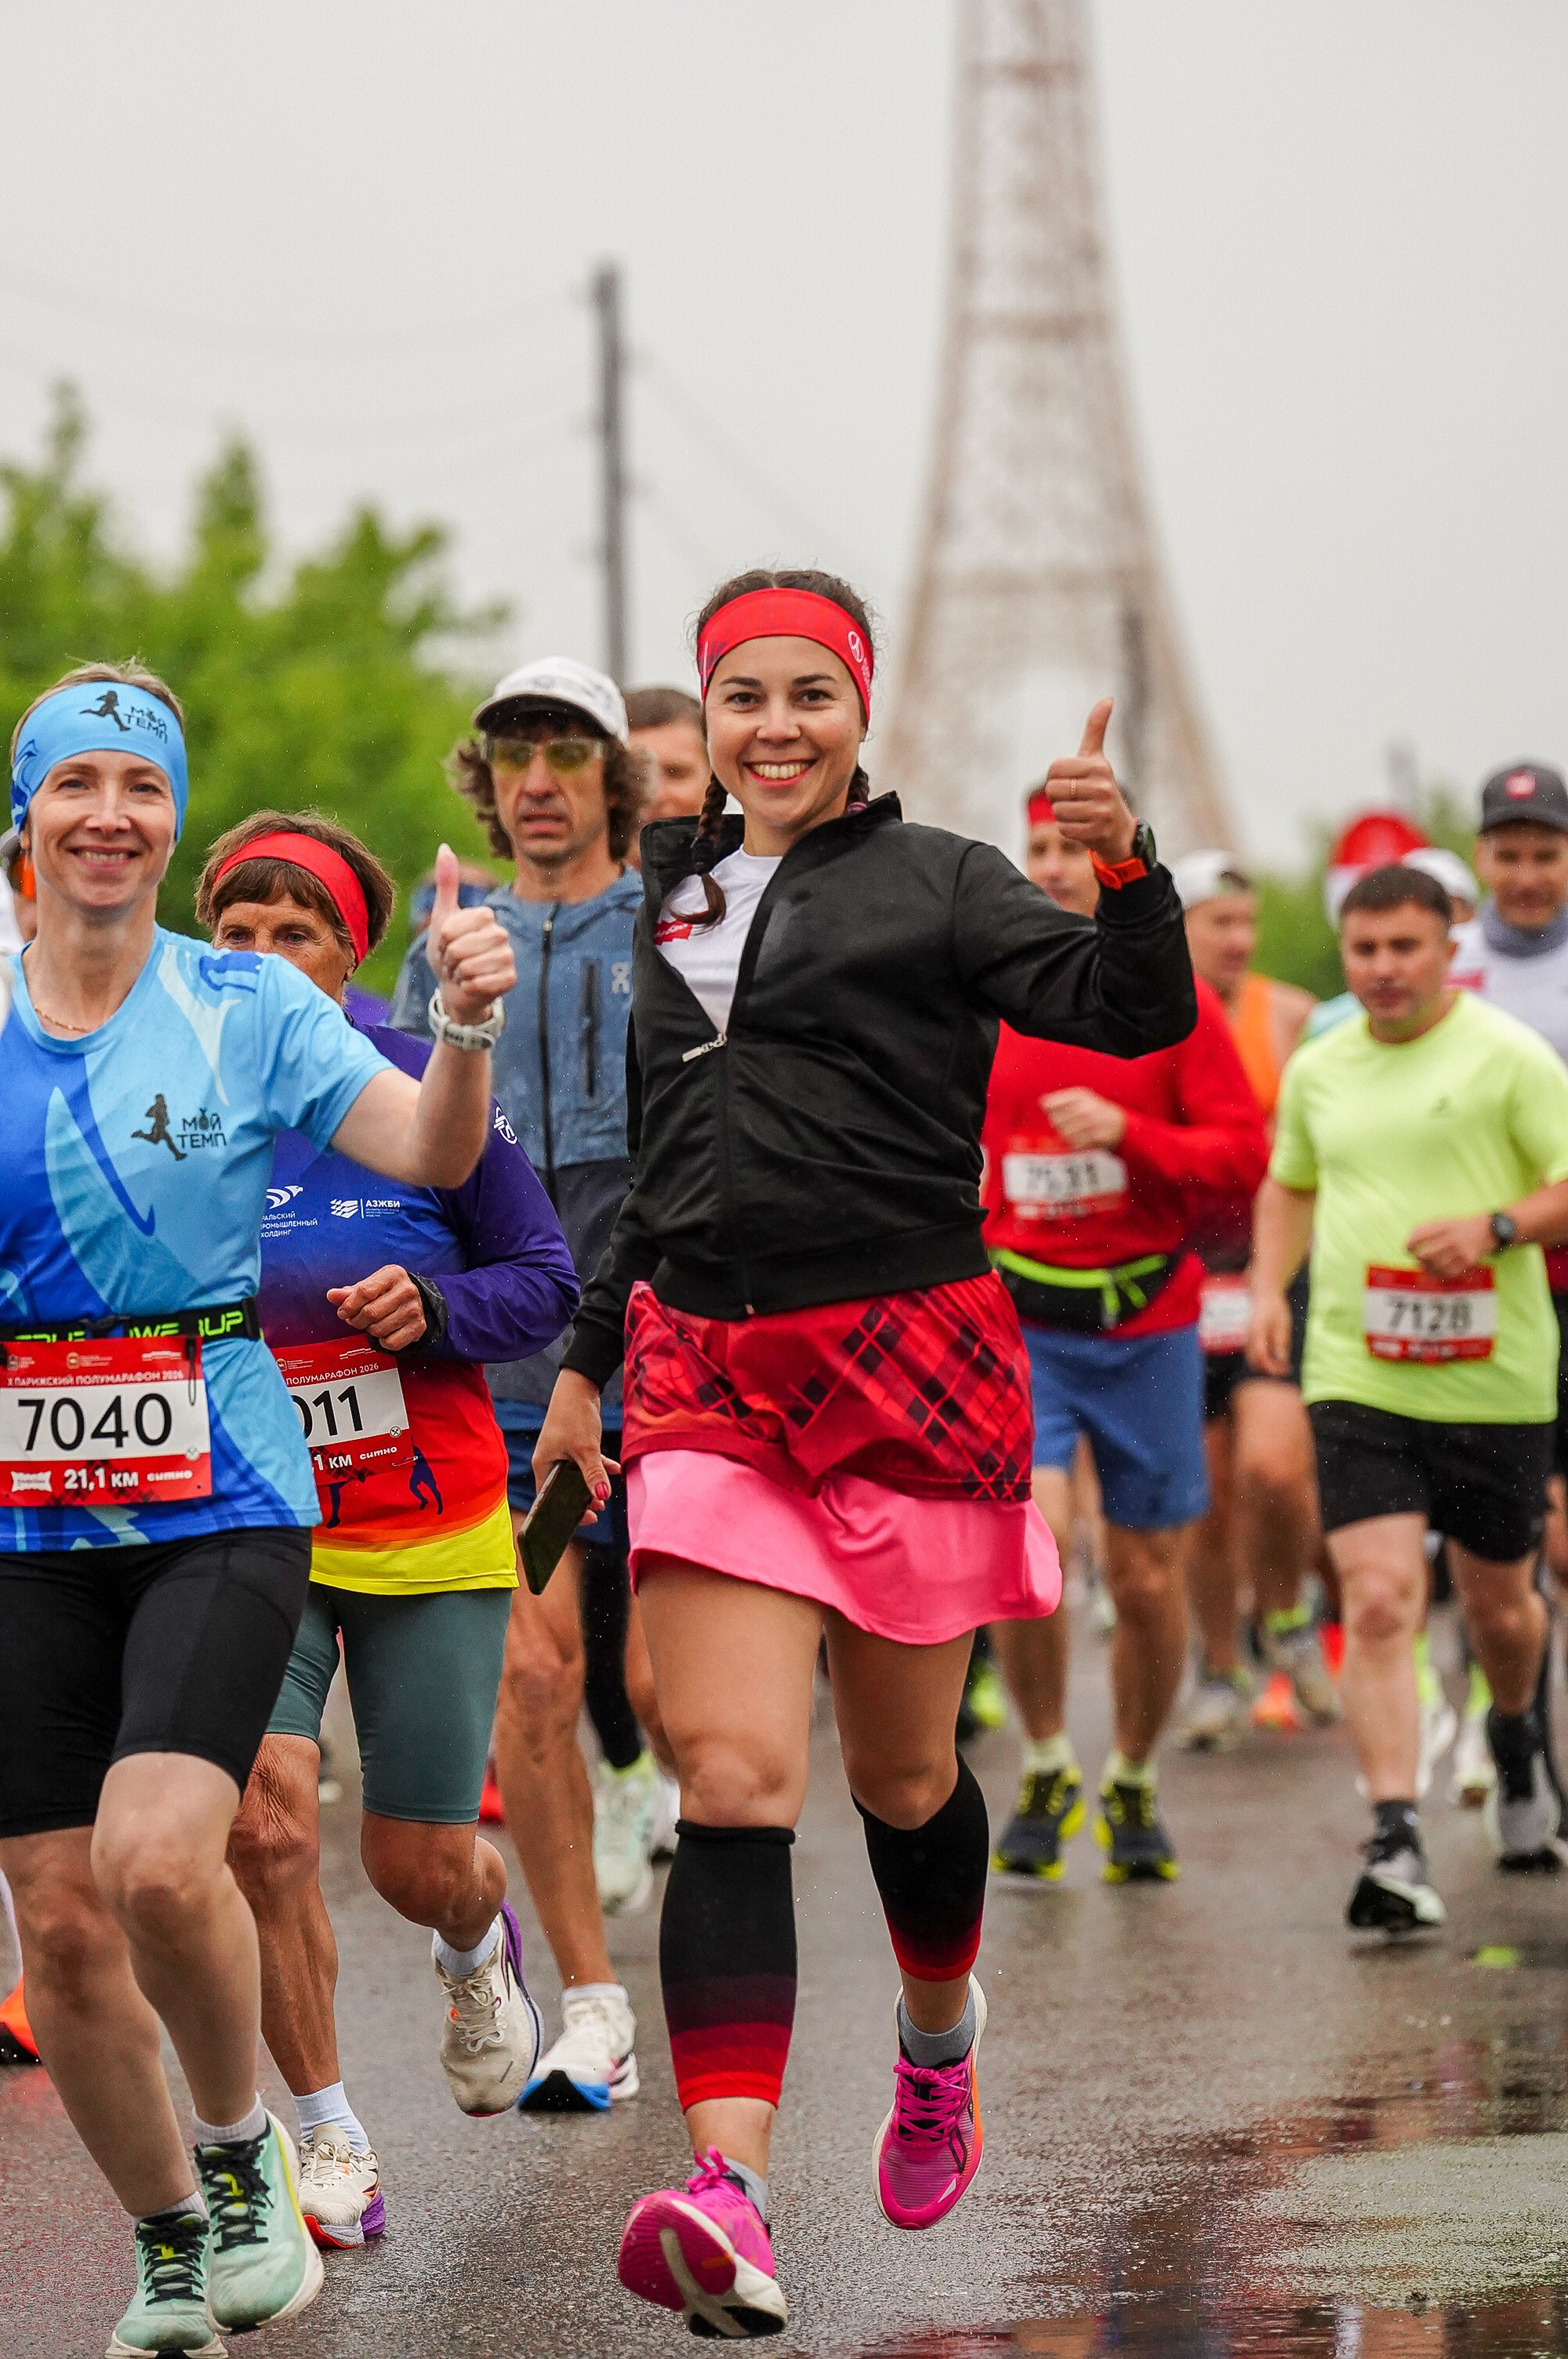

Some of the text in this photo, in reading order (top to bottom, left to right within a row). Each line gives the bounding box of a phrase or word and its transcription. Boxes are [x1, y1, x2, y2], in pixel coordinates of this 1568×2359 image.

[176, 1132, 227, 1149] ТЕМП
[365, 1199, 401, 1208] АЗЖБИ
[260, 1229, 292, 1238] ХОЛДИНГ
[15, 1374, 74, 1386] ПАРИЖСКИЙ
[76, 1371, 161, 1385] ПОЛУМАРАФОН
[286, 1363, 379, 1385] ПОЛУМАРАФОН 2026
[17, 1393, 172, 1451] 7040
[329, 1454, 353, 1469] КМ
[64, 1467, 139, 1491] 21,1 КМ
